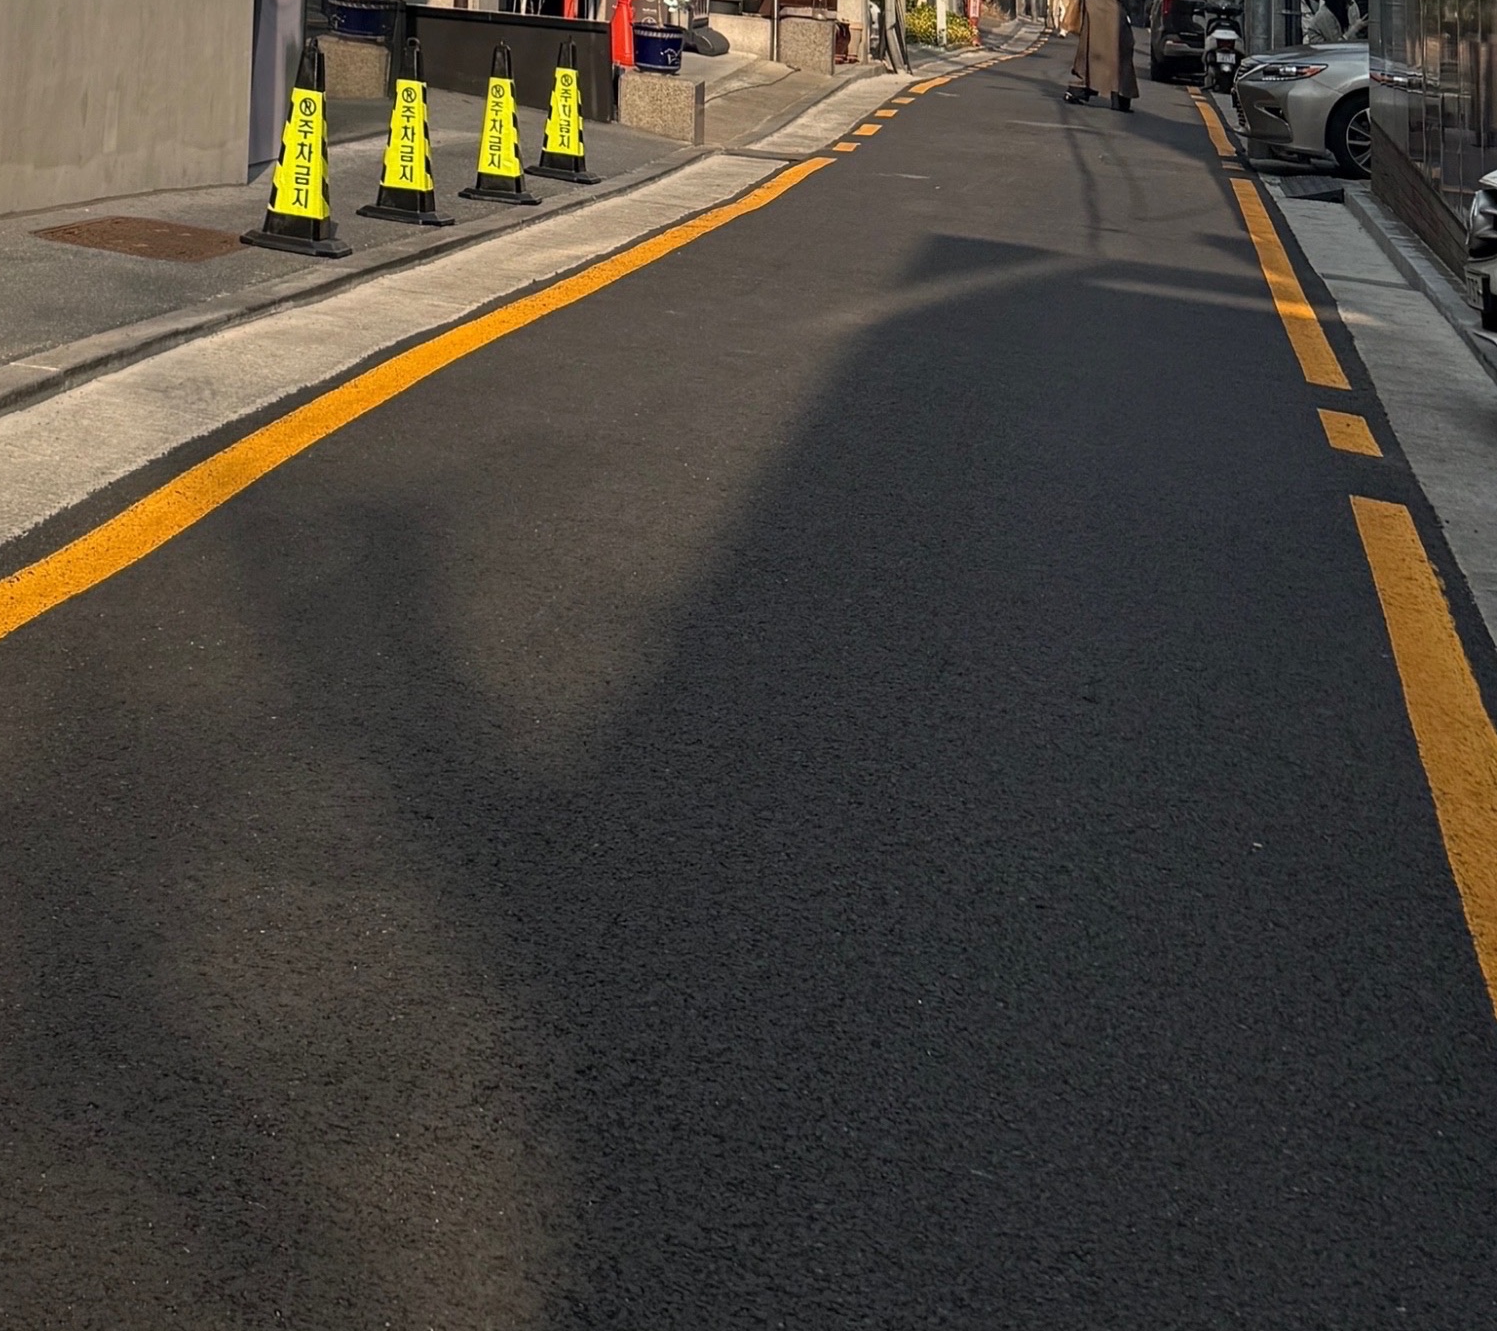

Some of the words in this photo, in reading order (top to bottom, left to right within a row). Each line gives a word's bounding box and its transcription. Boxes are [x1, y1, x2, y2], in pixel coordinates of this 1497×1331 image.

[399, 105, 416, 183] 주차금지
[487, 101, 504, 170] 주차금지
[557, 88, 572, 149] 주차금지
[291, 119, 315, 209] 주차금지
